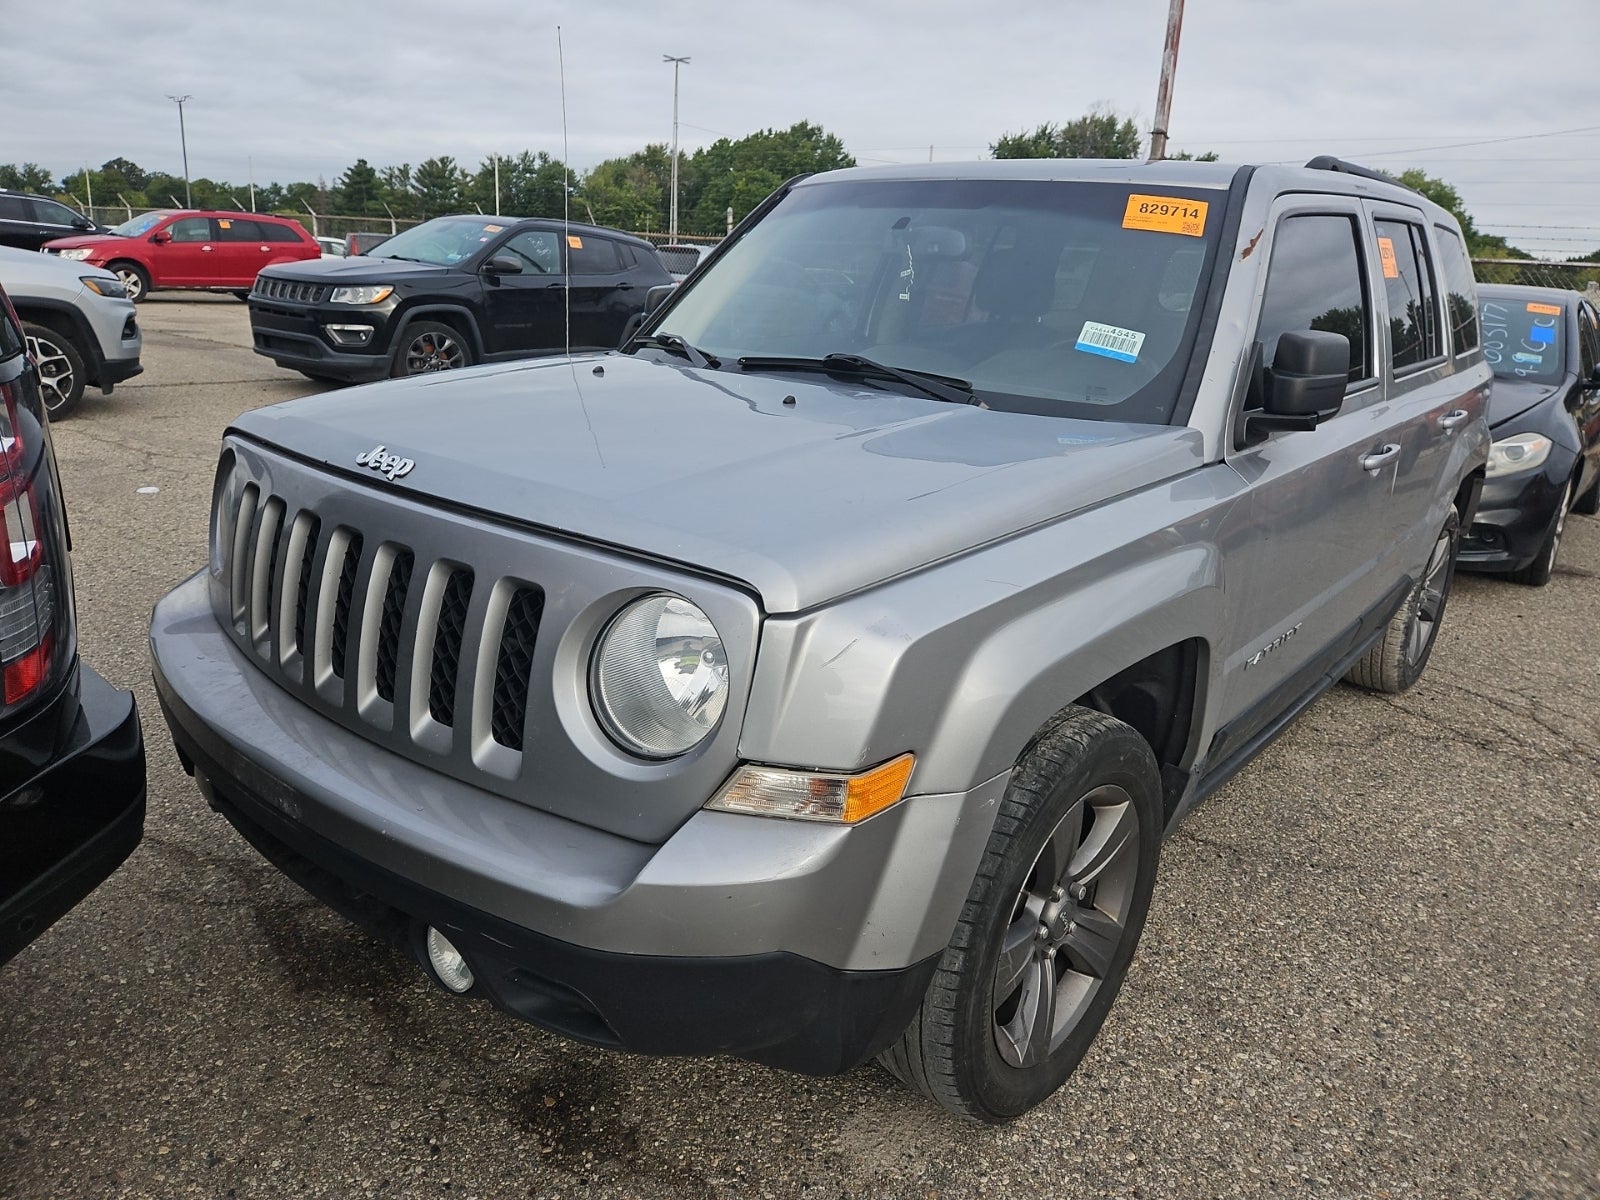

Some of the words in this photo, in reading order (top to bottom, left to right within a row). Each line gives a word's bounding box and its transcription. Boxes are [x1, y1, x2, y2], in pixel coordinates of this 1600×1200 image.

[1139, 202, 1199, 219] 829714
[355, 444, 416, 482] Jeep
[1243, 622, 1303, 672] PATRIOT
